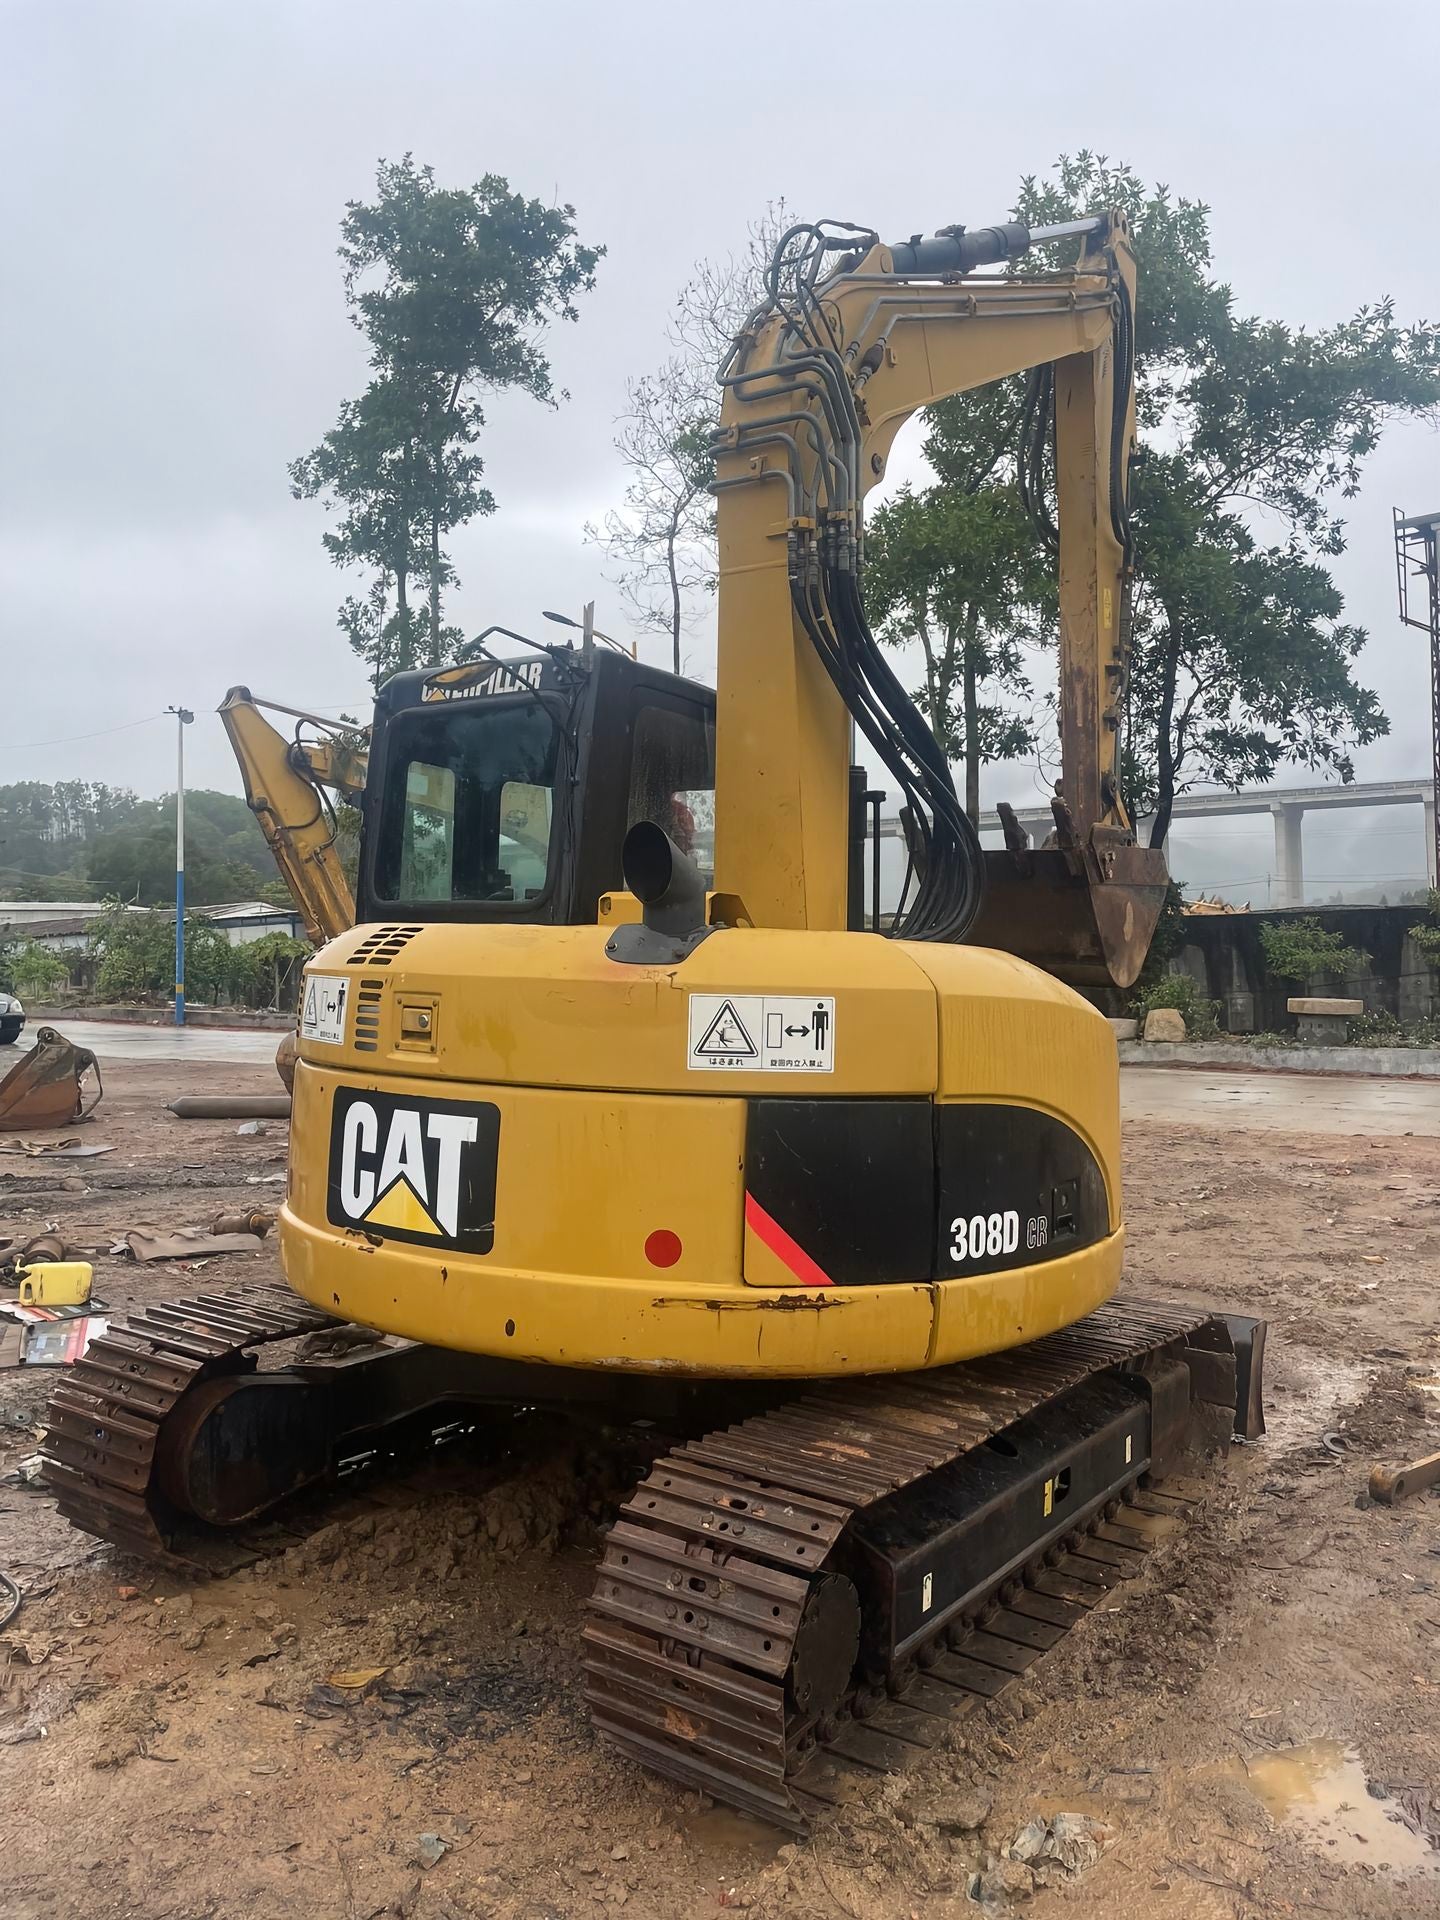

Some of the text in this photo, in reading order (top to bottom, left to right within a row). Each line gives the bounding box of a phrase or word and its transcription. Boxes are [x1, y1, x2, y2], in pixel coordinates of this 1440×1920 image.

[709, 1057, 744, 1066] はさまれ
[340, 1101, 479, 1238] CAT
[950, 1210, 1048, 1262] 308D CR
